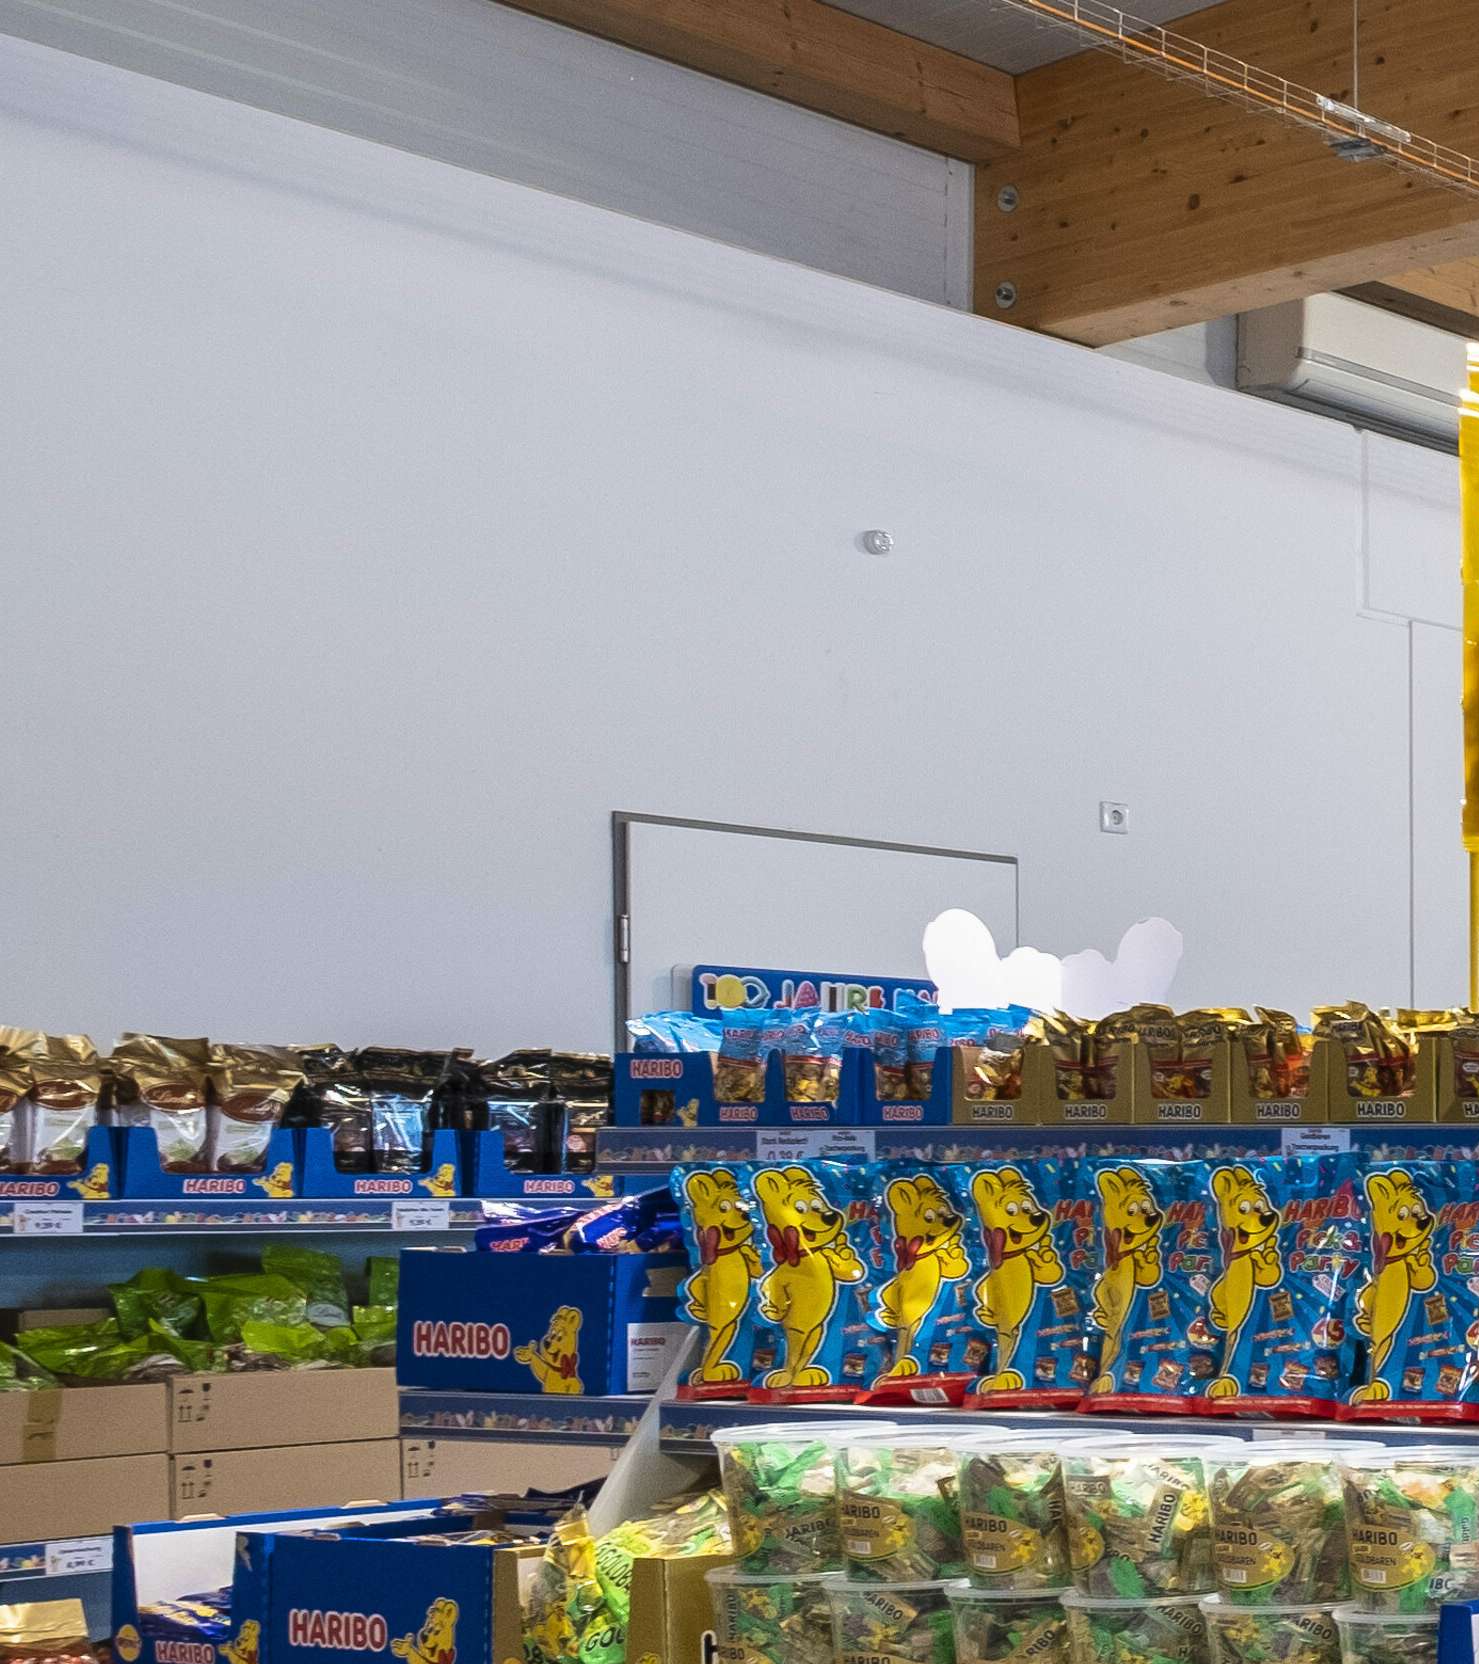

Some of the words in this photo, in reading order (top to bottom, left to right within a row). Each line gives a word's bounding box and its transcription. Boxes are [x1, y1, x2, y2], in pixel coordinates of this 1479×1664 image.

[630, 1059, 683, 1079] HARIBO
[971, 1104, 1013, 1121] HARIBO
[1157, 1103, 1202, 1120] HARIBO
[354, 1178, 413, 1194] HARIBO
[523, 1180, 575, 1194] HARIBO
[413, 1322, 510, 1360] HARIBO
[1148, 1494, 1177, 1544] HARIBO
[289, 1608, 388, 1652] HARIBO
